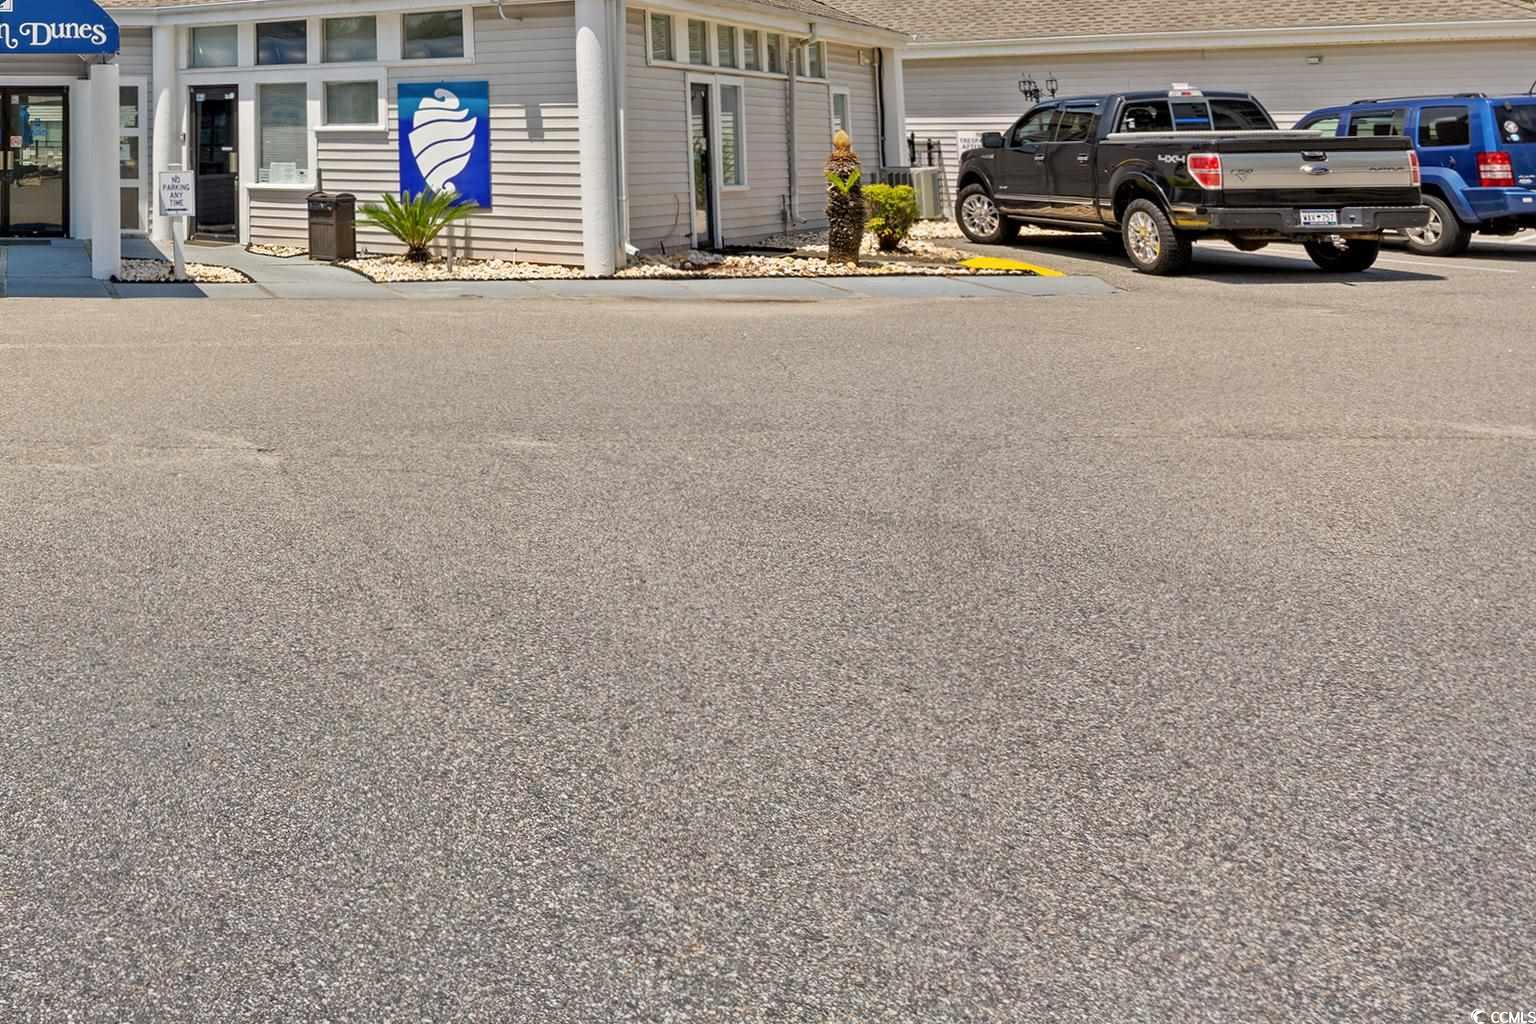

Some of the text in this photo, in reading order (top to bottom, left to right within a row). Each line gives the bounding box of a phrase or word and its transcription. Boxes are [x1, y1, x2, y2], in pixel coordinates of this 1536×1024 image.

[19, 21, 107, 46] Dunes
[162, 183, 190, 191] PARKING
[169, 199, 184, 207] TIME
